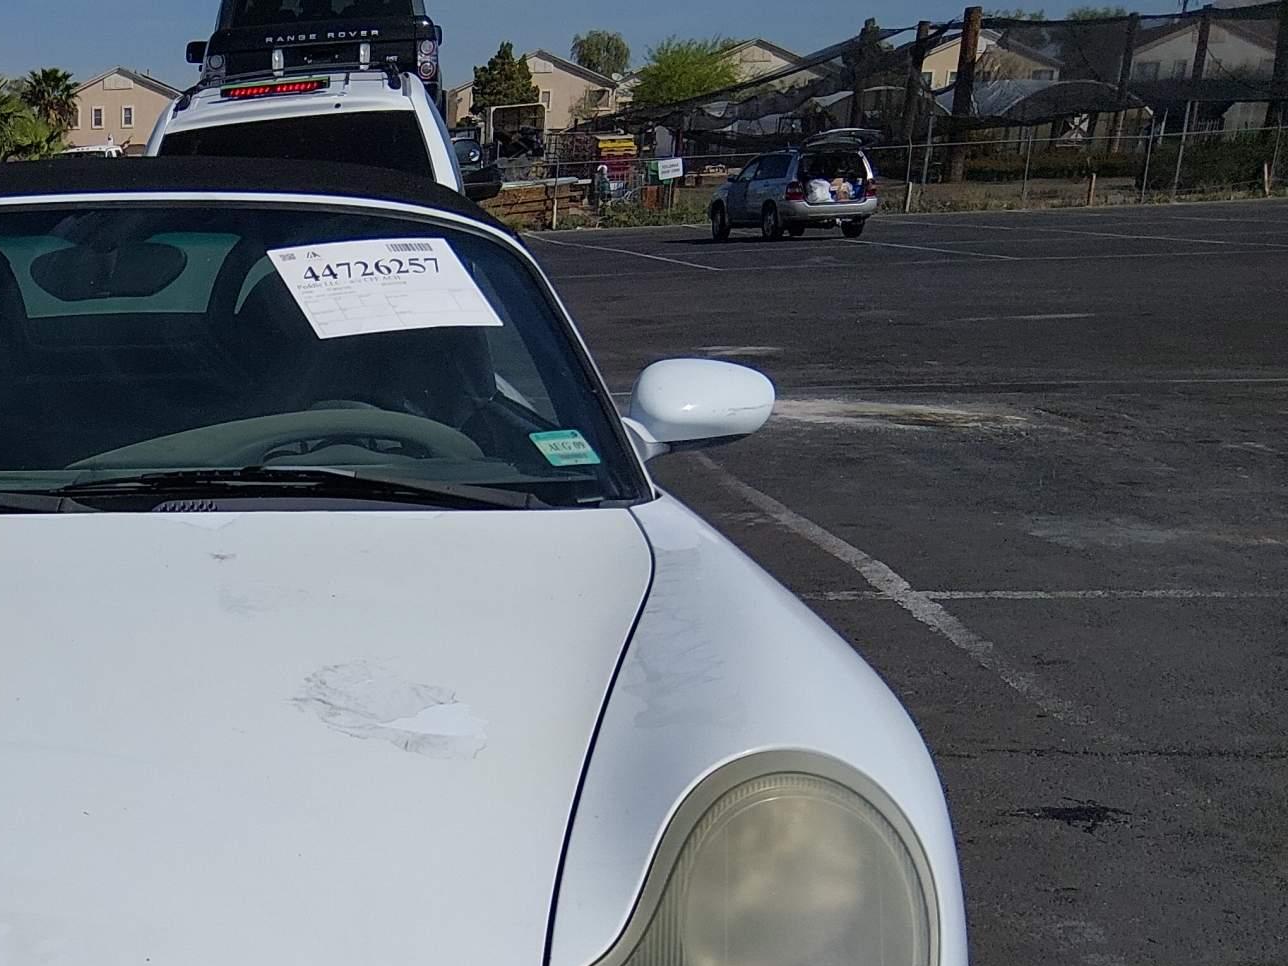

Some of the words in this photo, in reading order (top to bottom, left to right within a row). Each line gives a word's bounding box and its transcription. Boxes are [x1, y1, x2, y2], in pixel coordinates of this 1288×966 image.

[265, 33, 317, 44] RANGE
[327, 29, 379, 39] ROVER
[303, 257, 440, 282] 44726257
